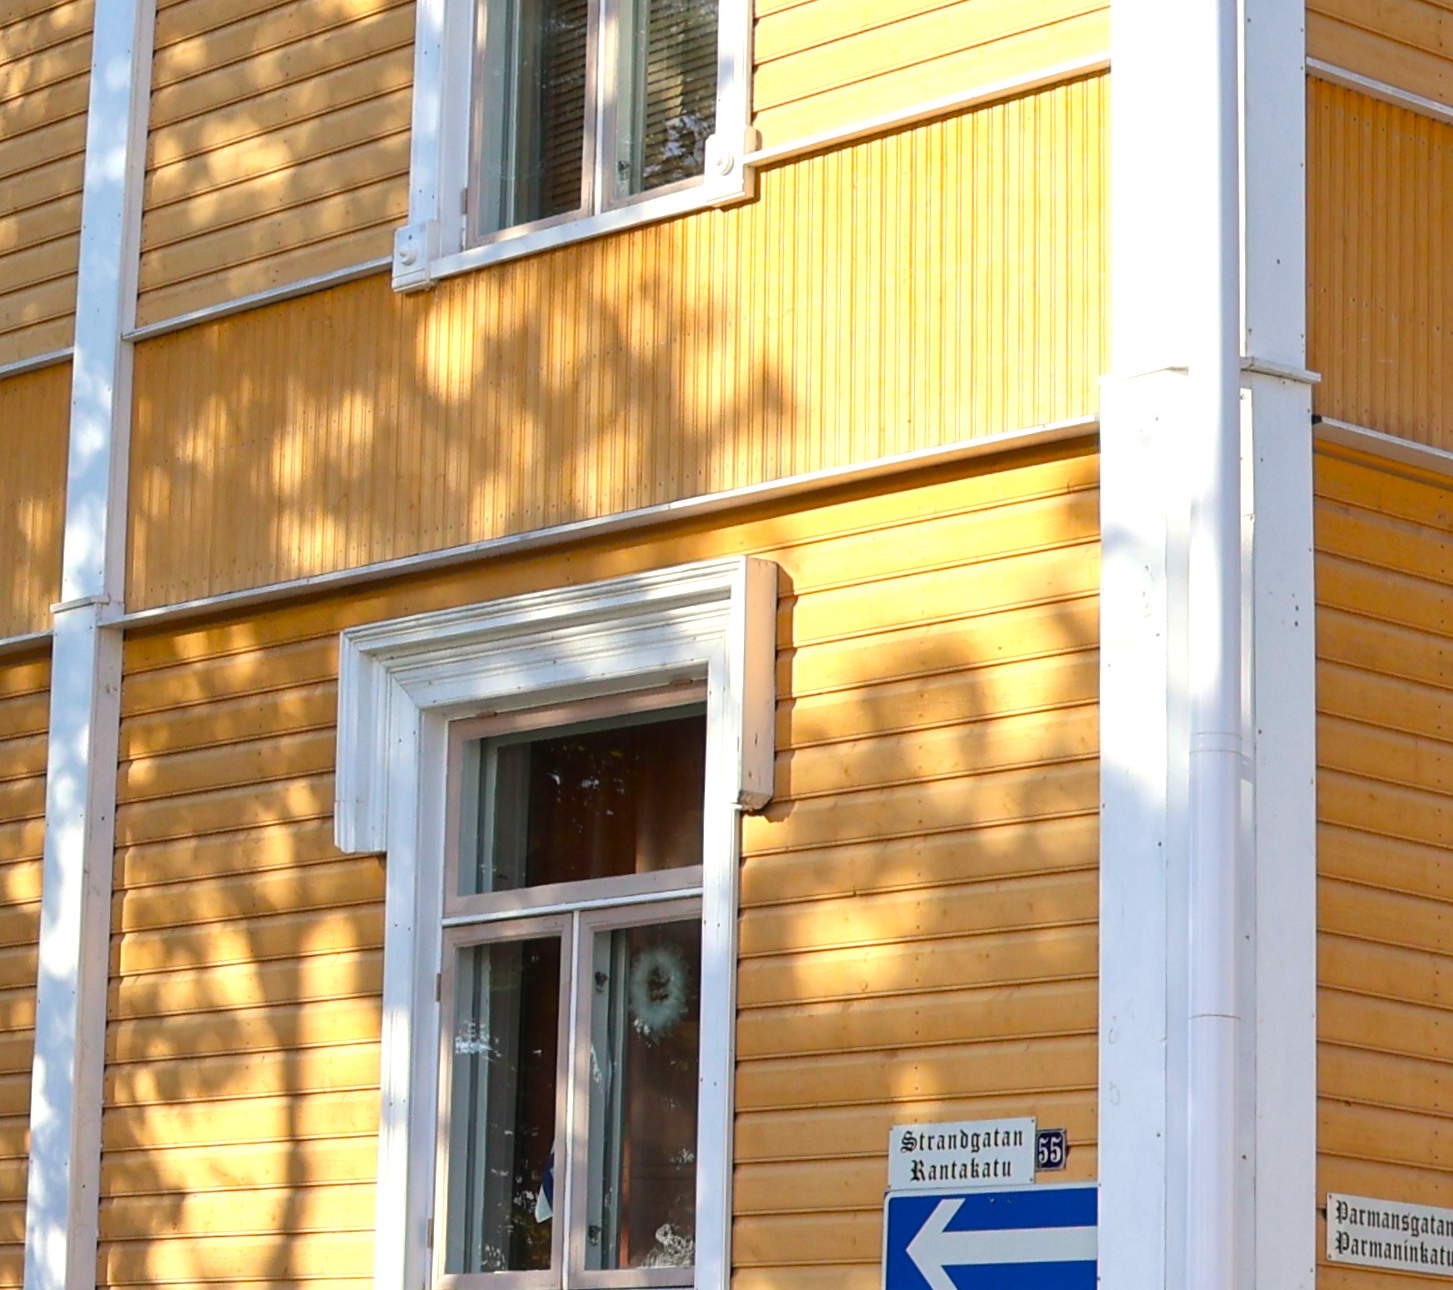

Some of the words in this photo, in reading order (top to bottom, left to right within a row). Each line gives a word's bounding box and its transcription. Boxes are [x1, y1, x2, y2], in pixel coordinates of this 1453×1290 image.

[900, 1128, 1023, 1153] Strandgatan
[1038, 1136, 1062, 1163] 55
[910, 1157, 1012, 1182] Rantakatu
